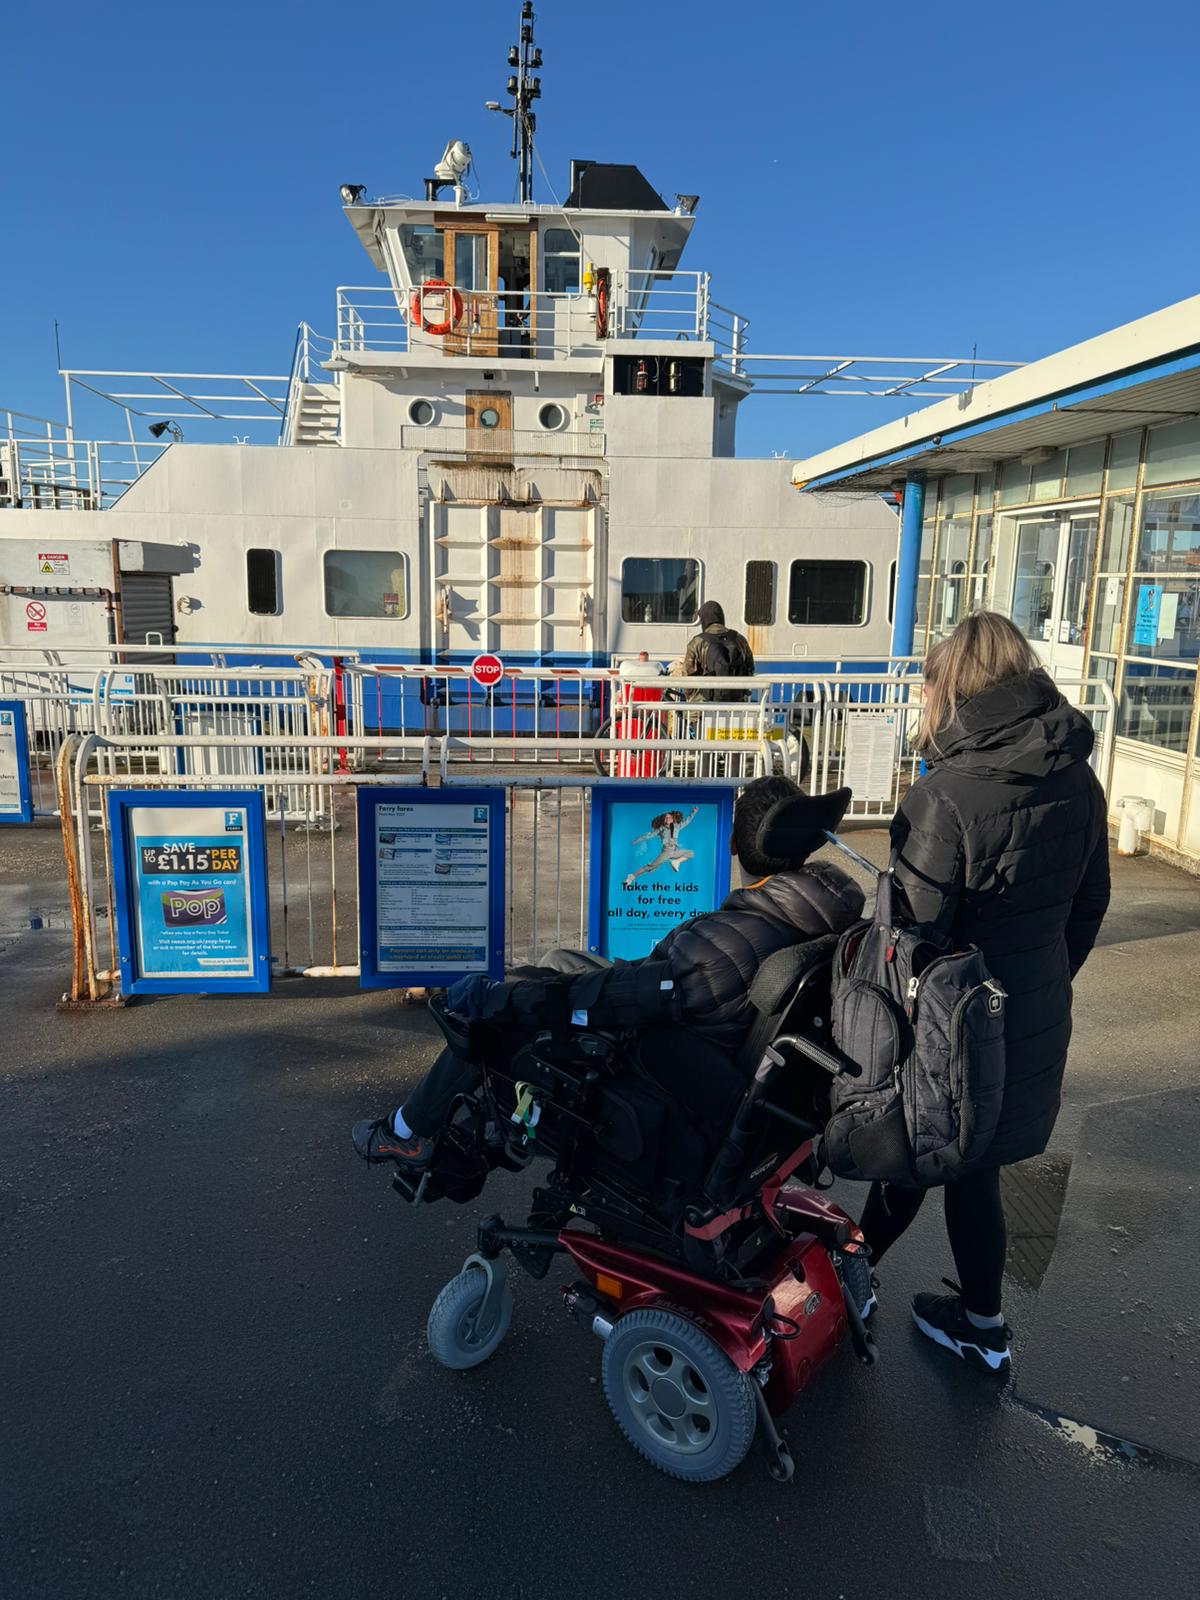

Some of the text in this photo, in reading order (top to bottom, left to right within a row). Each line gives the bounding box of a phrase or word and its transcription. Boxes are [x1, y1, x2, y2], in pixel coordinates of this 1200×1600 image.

[475, 665, 500, 674] STOP
[478, 808, 485, 818] F
[229, 813, 238, 825] F
[163, 842, 196, 854] SAVE
[211, 849, 236, 859] PER
[212, 860, 239, 870] DAY
[622, 882, 699, 892] Take the kids
[638, 895, 681, 905] for free
[170, 898, 220, 919] Pop
[608, 908, 622, 917] all
[626, 908, 650, 919] day,
[654, 910, 685, 919] every
